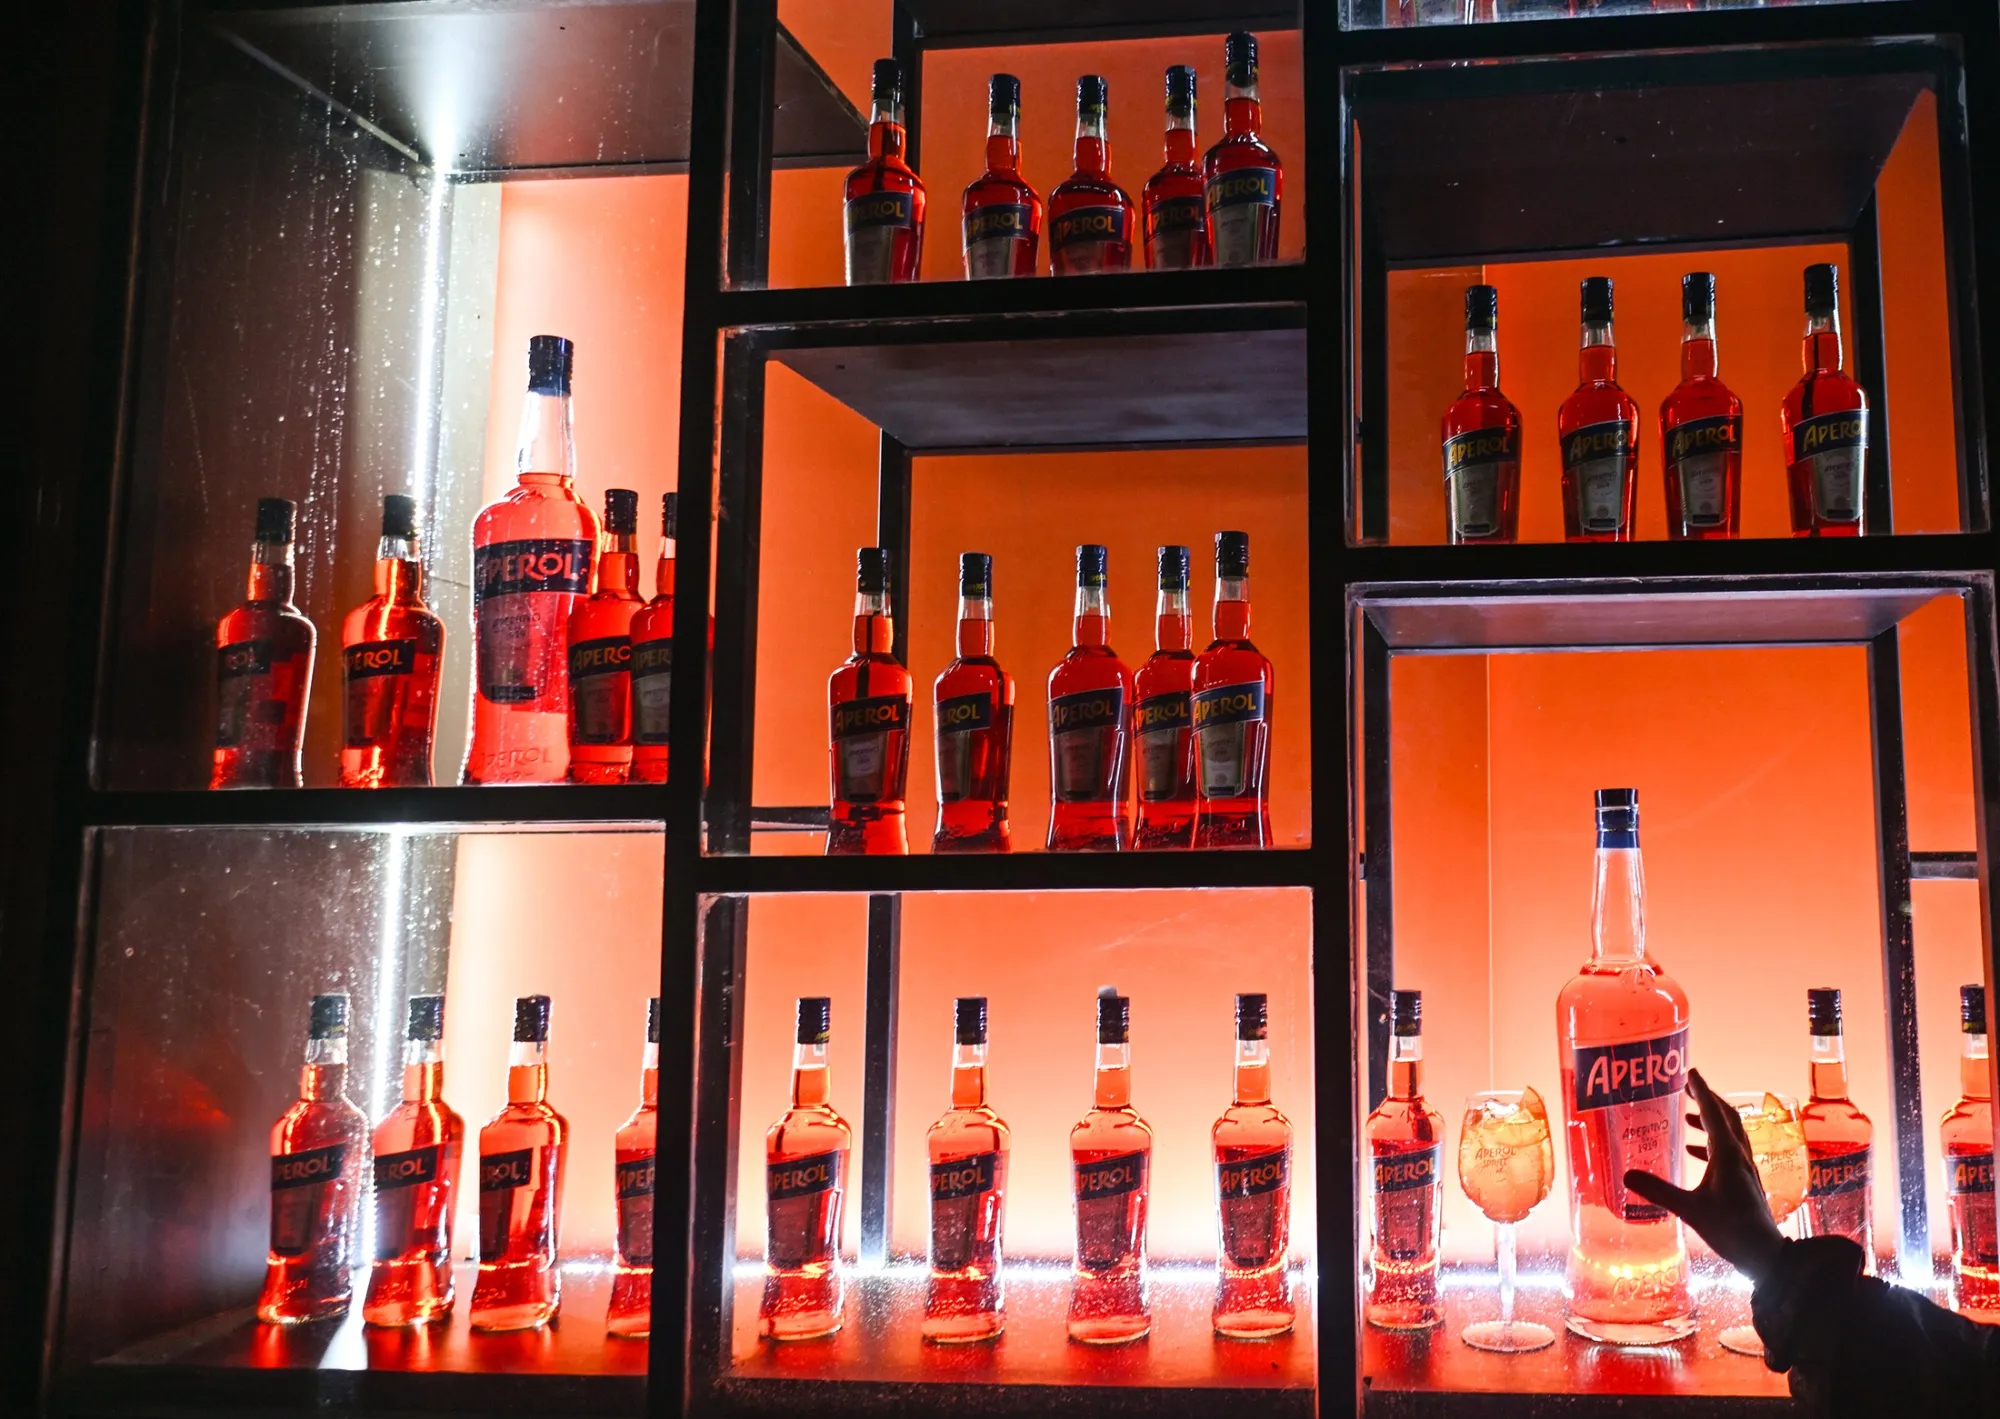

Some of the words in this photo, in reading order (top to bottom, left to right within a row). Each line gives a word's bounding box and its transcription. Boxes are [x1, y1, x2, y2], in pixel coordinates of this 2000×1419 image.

[1208, 177, 1268, 205] APEROL
[1056, 215, 1115, 242] APEROL
[1448, 437, 1509, 468] APEROL
[1672, 424, 1736, 457] APEROL
[1053, 699, 1113, 728] APEROL
[1192, 693, 1255, 726] APEROL
[1586, 1047, 1687, 1098] APEROL
[1475, 1147, 1516, 1160] APEROL
[1637, 1140, 1658, 1153] 1919
[1220, 1161, 1283, 1193] APEROL
[1375, 1157, 1436, 1186] APEROL
